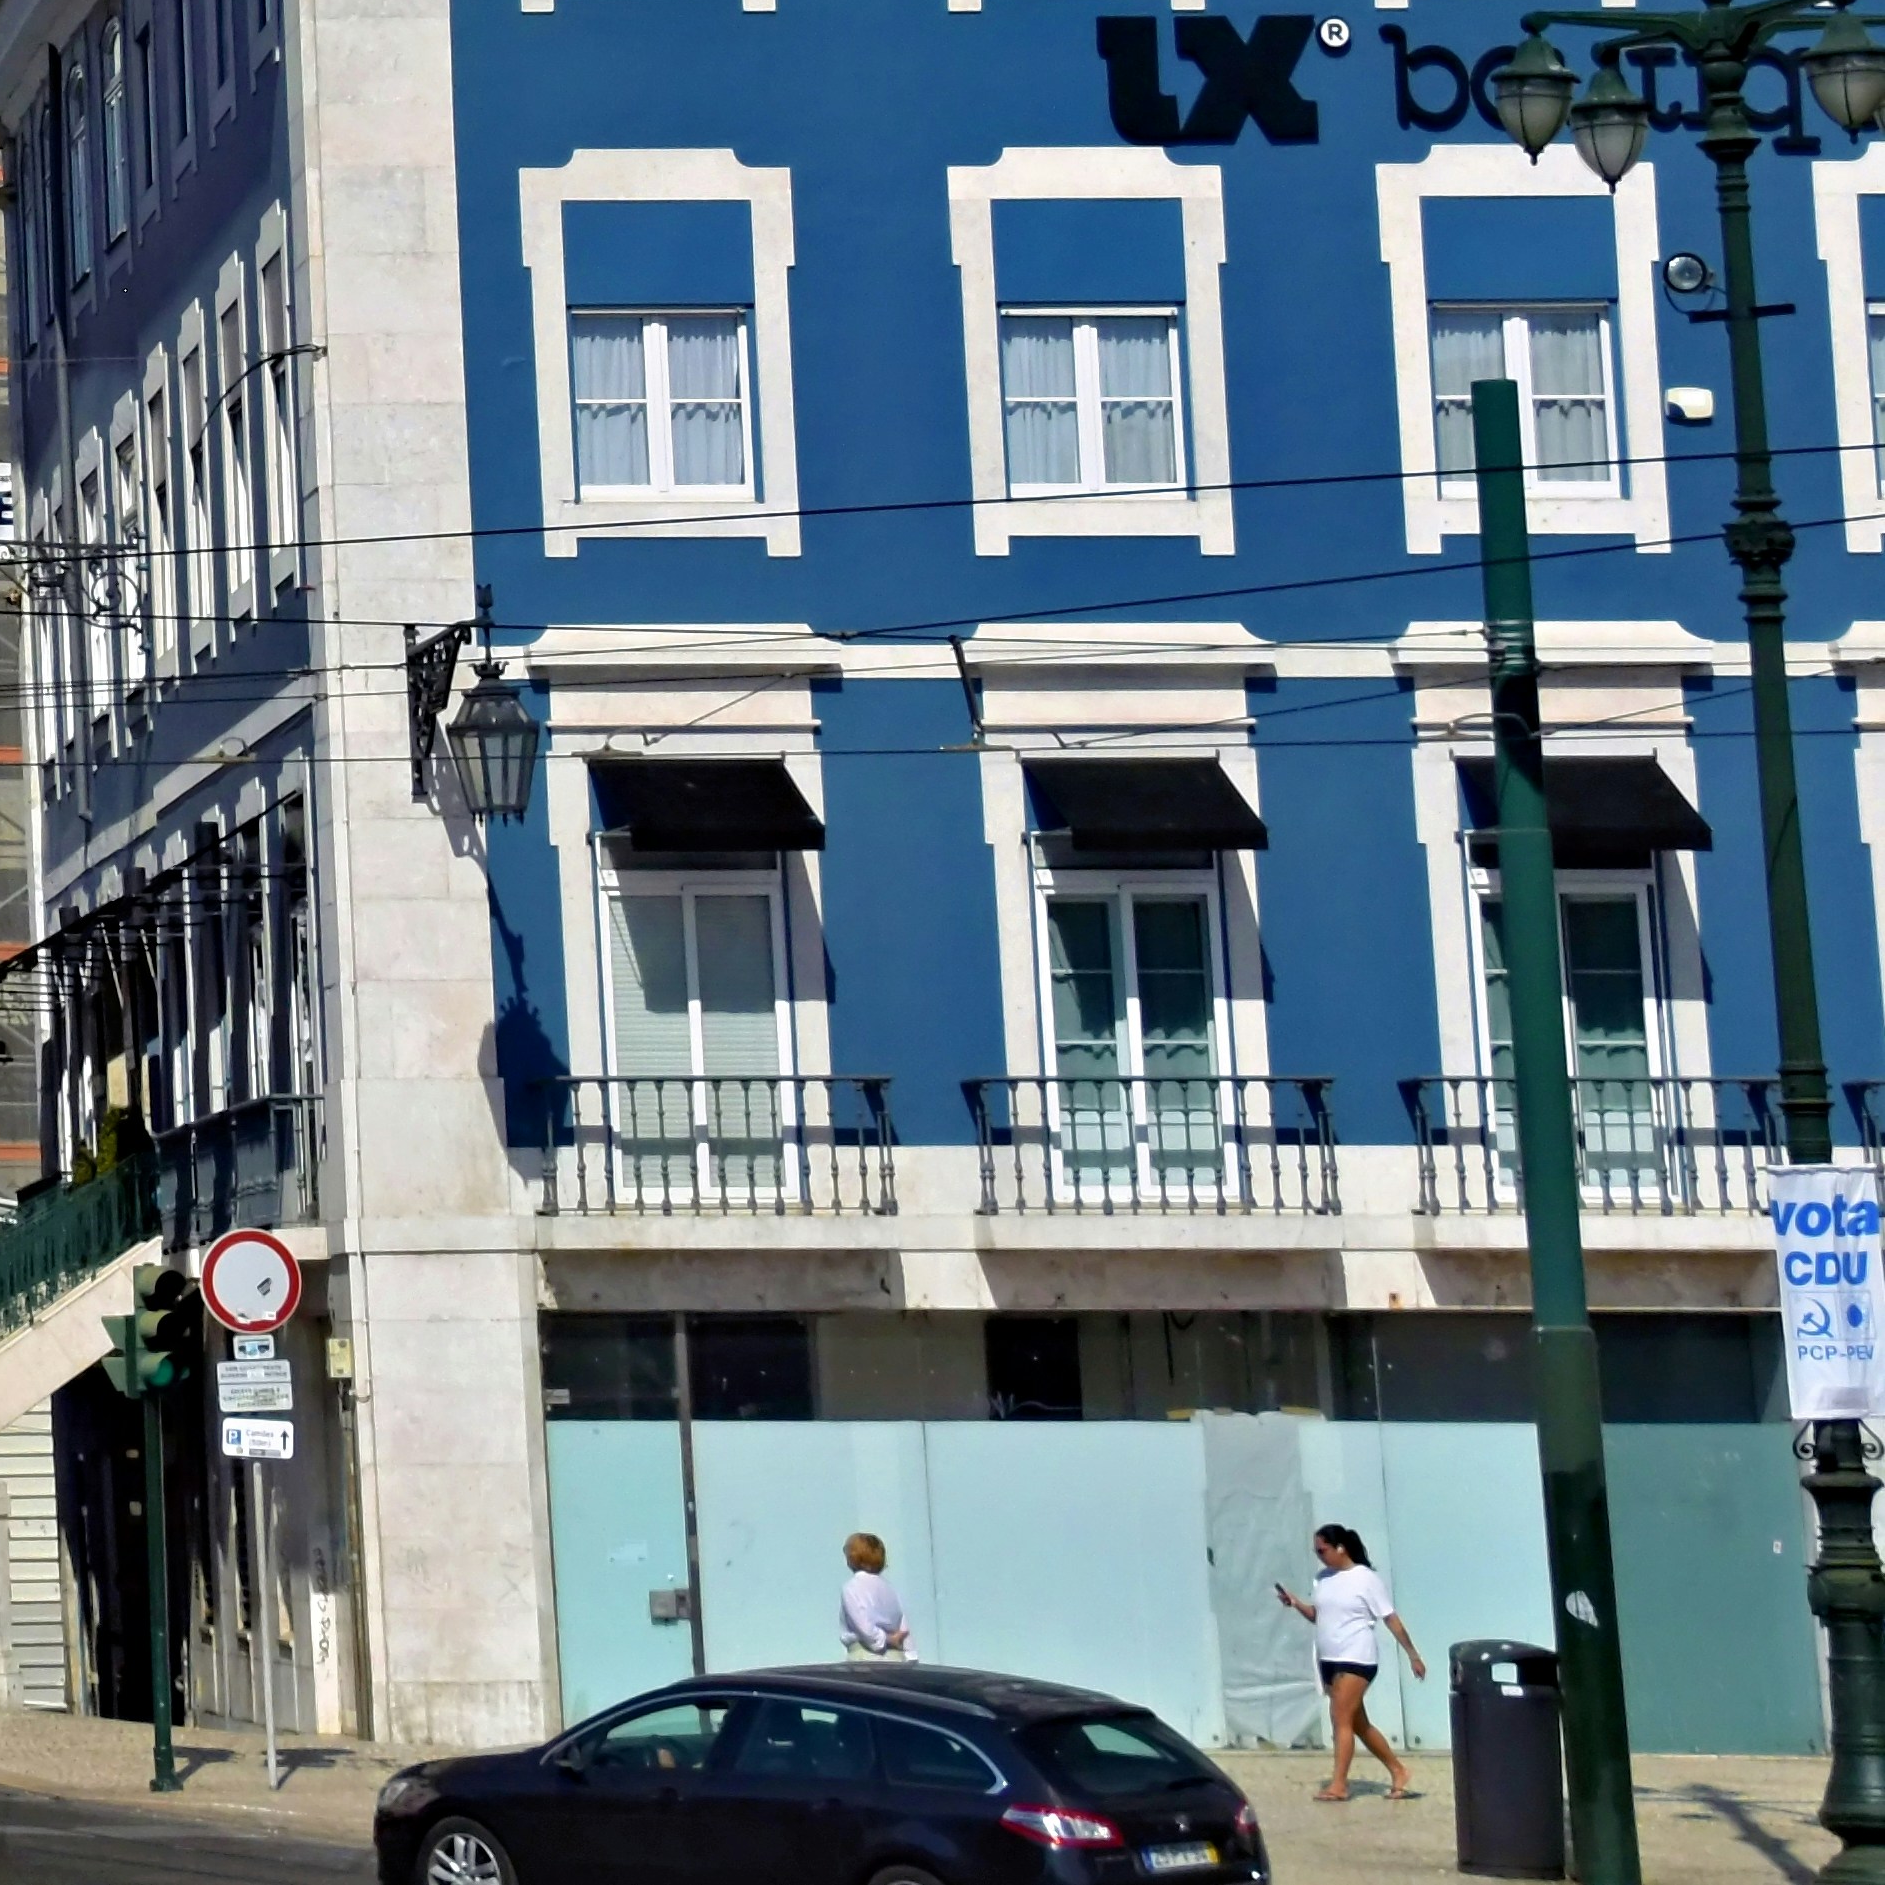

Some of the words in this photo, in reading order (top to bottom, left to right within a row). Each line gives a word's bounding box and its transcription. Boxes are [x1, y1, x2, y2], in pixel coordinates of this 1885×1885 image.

[1771, 1193, 1880, 1237] vota
[1784, 1251, 1868, 1286] CDU
[1797, 1345, 1874, 1361] PCP-PEV
